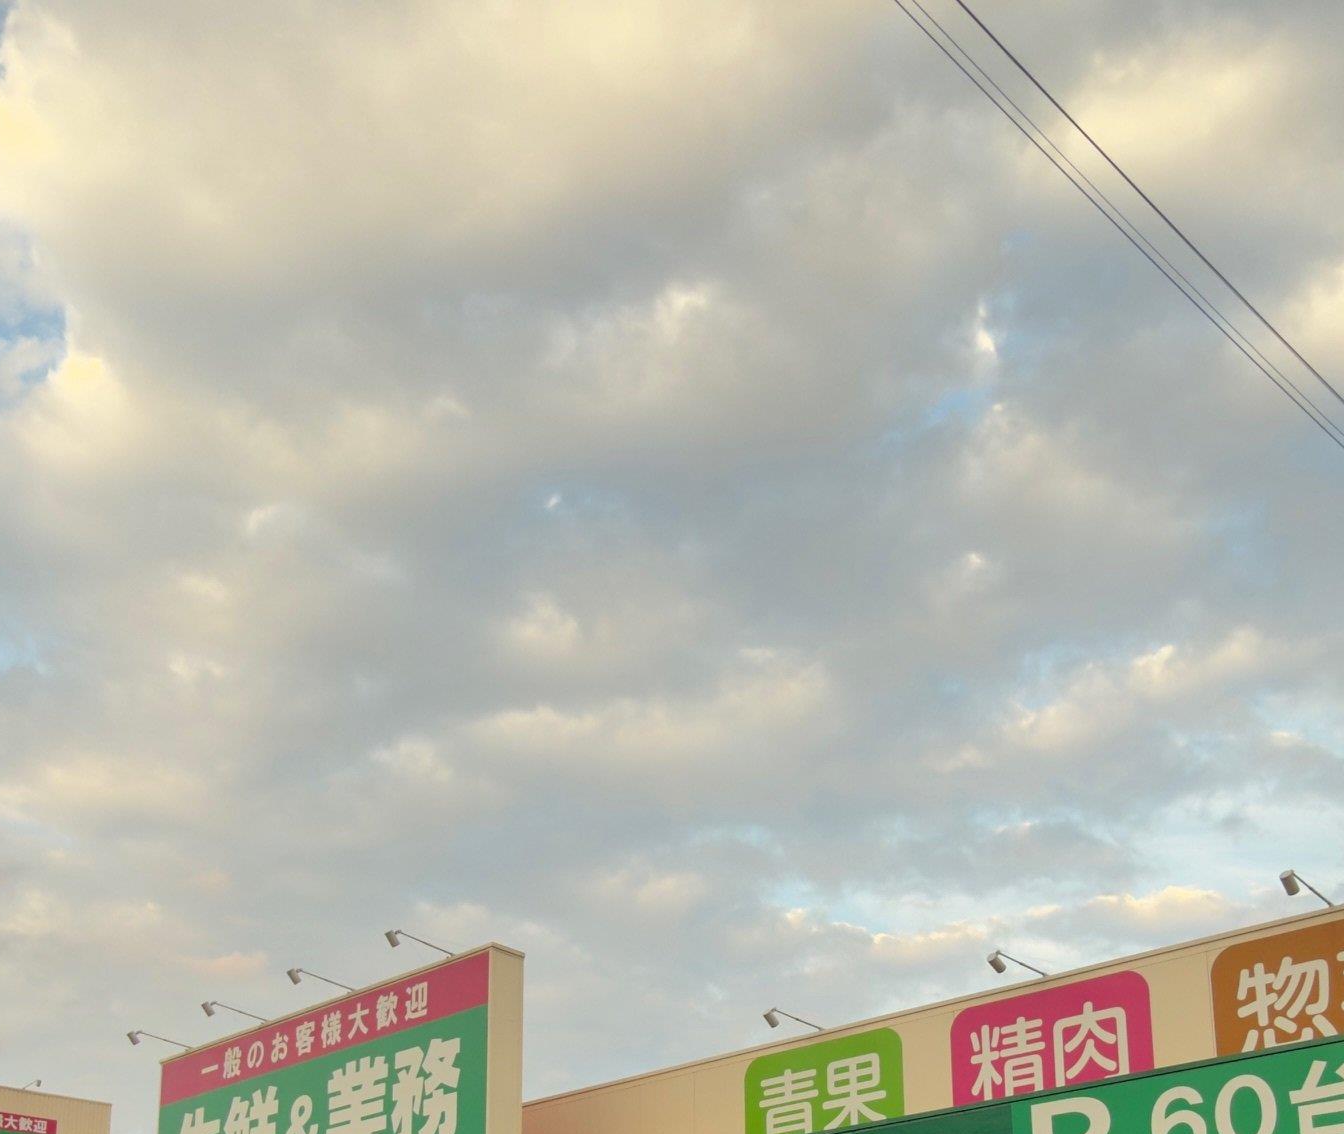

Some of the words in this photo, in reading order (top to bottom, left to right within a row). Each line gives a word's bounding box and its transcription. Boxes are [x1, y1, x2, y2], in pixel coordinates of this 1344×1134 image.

[201, 982, 428, 1079] 一般のお客様大歓迎
[970, 1002, 1130, 1100] 精肉
